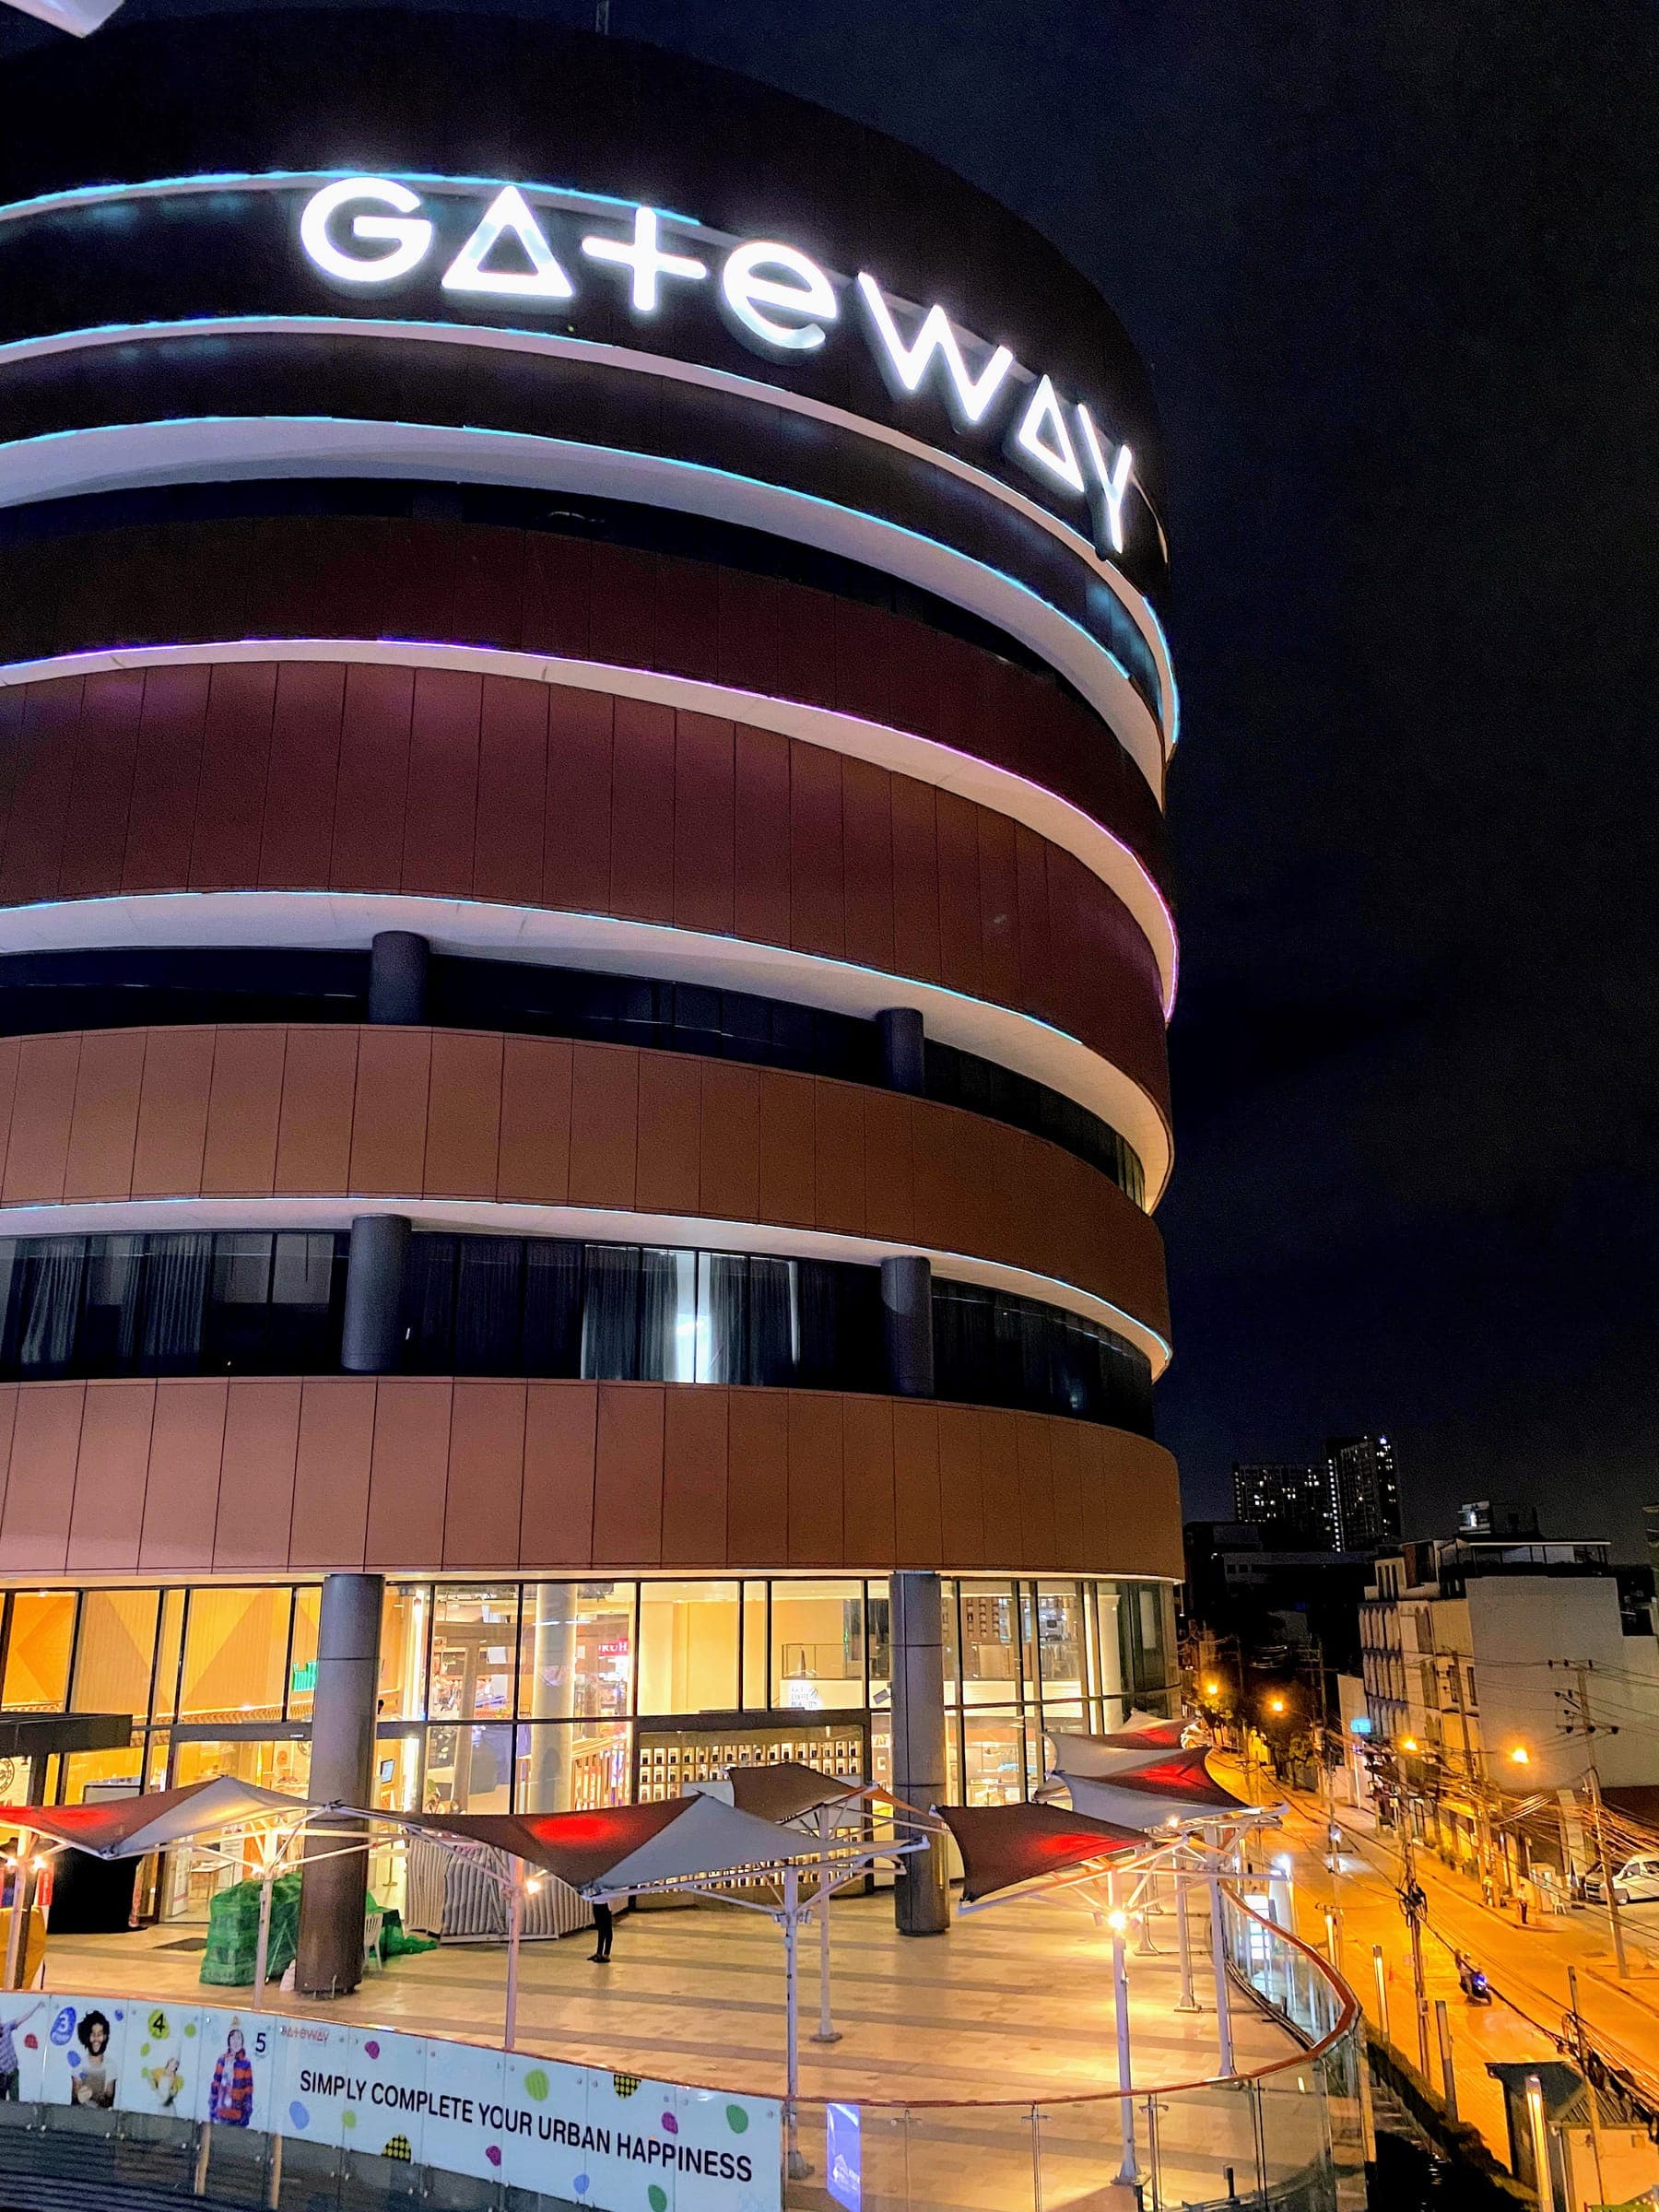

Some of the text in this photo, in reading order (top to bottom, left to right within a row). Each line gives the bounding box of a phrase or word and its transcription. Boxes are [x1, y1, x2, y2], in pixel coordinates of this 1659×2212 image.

[59, 2015, 69, 2033] 3
[153, 2013, 166, 2033] 4
[255, 2032, 266, 2053] 5
[300, 2070, 752, 2183] SIMPLY COMPLETE YOUR URBAN HAPPINESS
